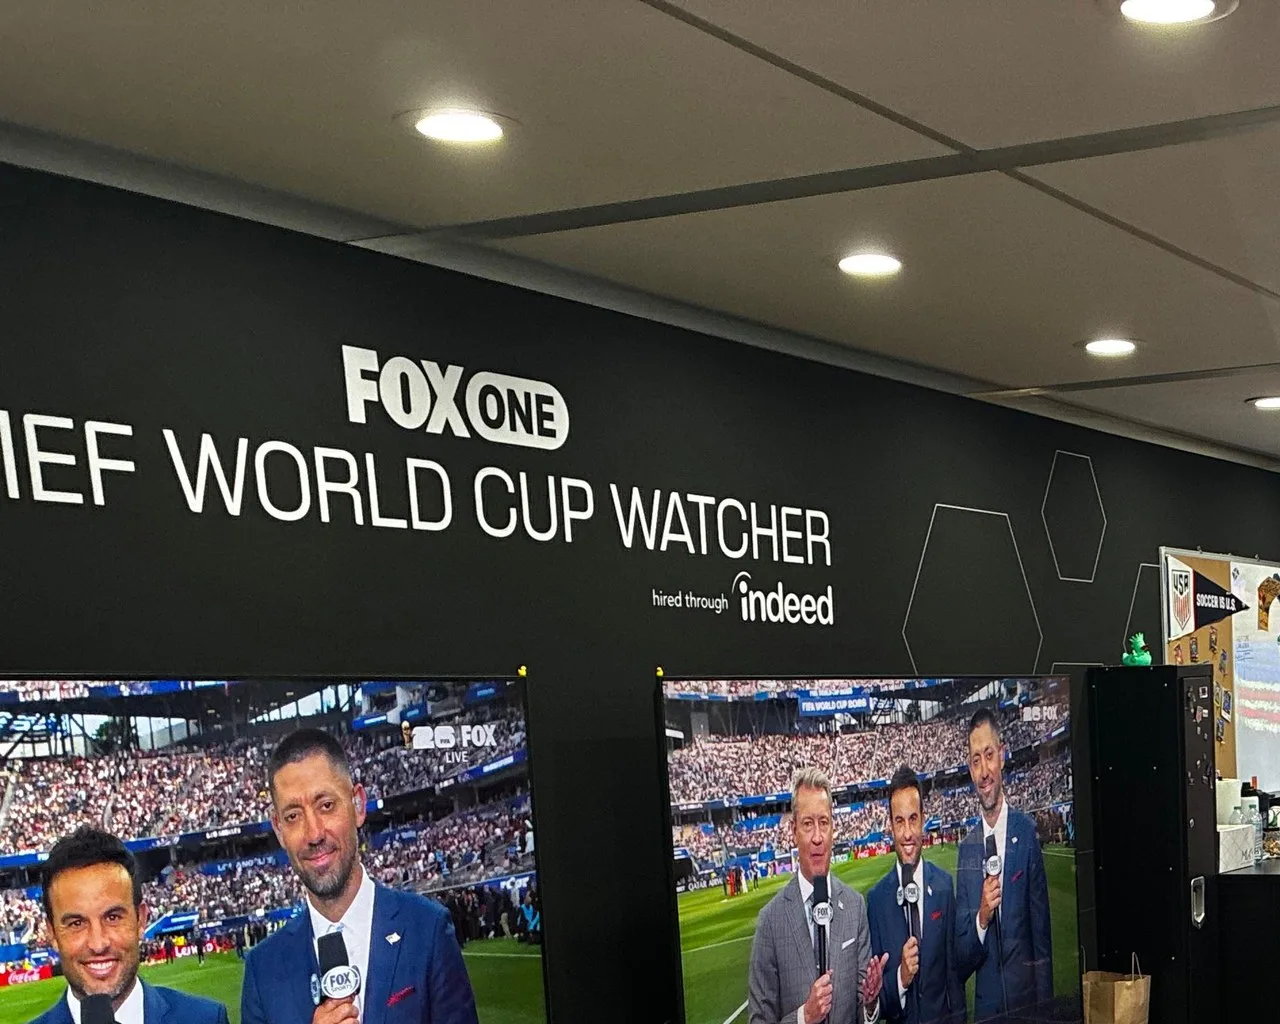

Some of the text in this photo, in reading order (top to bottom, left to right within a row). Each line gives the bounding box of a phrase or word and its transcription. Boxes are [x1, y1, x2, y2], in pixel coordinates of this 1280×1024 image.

[342, 344, 557, 439] FOX ONE
[163, 428, 452, 531] WORLD
[474, 466, 594, 543] CUP
[610, 483, 832, 567] WATCHER
[1172, 573, 1188, 596] USA
[652, 571, 834, 626] hired through indeed
[1196, 593, 1219, 609] SOCCER
[1225, 598, 1237, 611] U.S.
[1043, 705, 1058, 720] FOX
[461, 724, 498, 747] FOX
[446, 751, 469, 764] LIVE
[817, 907, 829, 916] FOX
[330, 972, 351, 987] FOX
